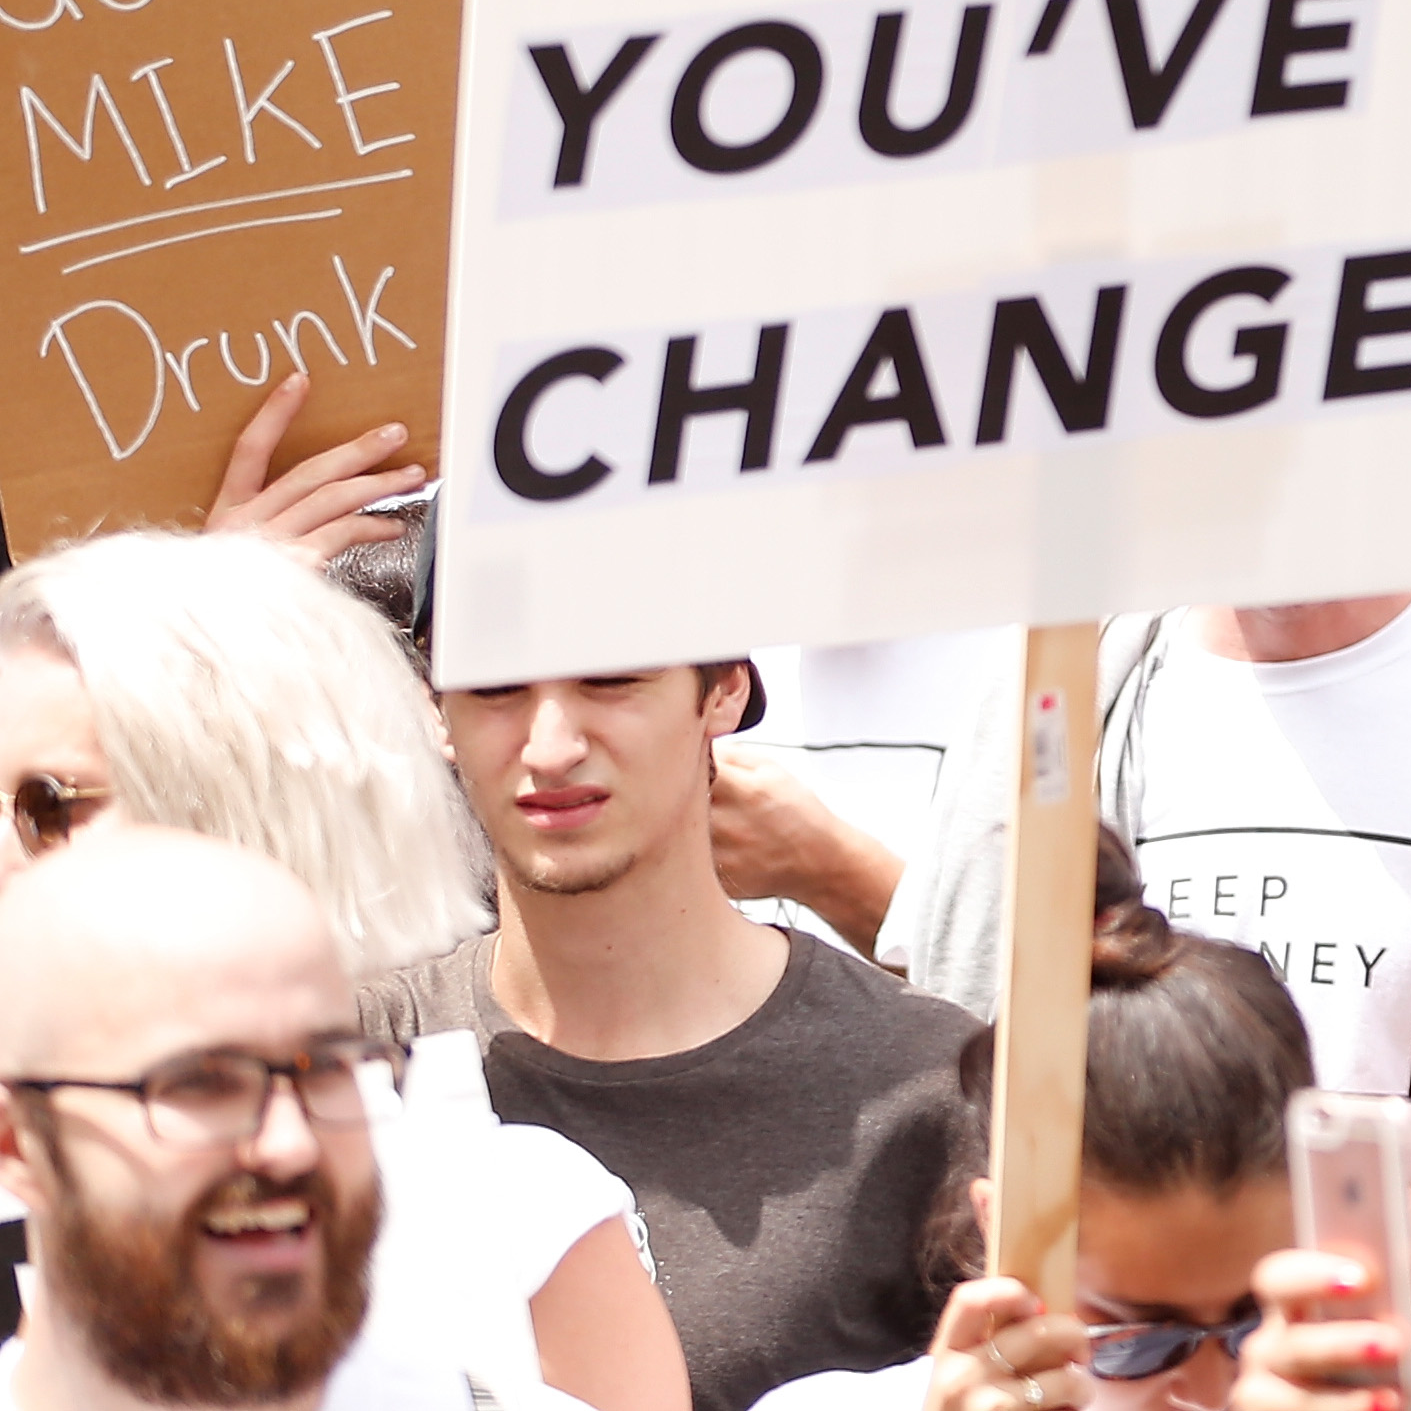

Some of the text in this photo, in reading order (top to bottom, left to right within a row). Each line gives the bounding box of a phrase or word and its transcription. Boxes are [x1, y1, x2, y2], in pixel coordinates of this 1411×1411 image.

[20, 10, 415, 214] MIKE
[40, 255, 417, 460] Drunk
[1141, 875, 1289, 920] EEP
